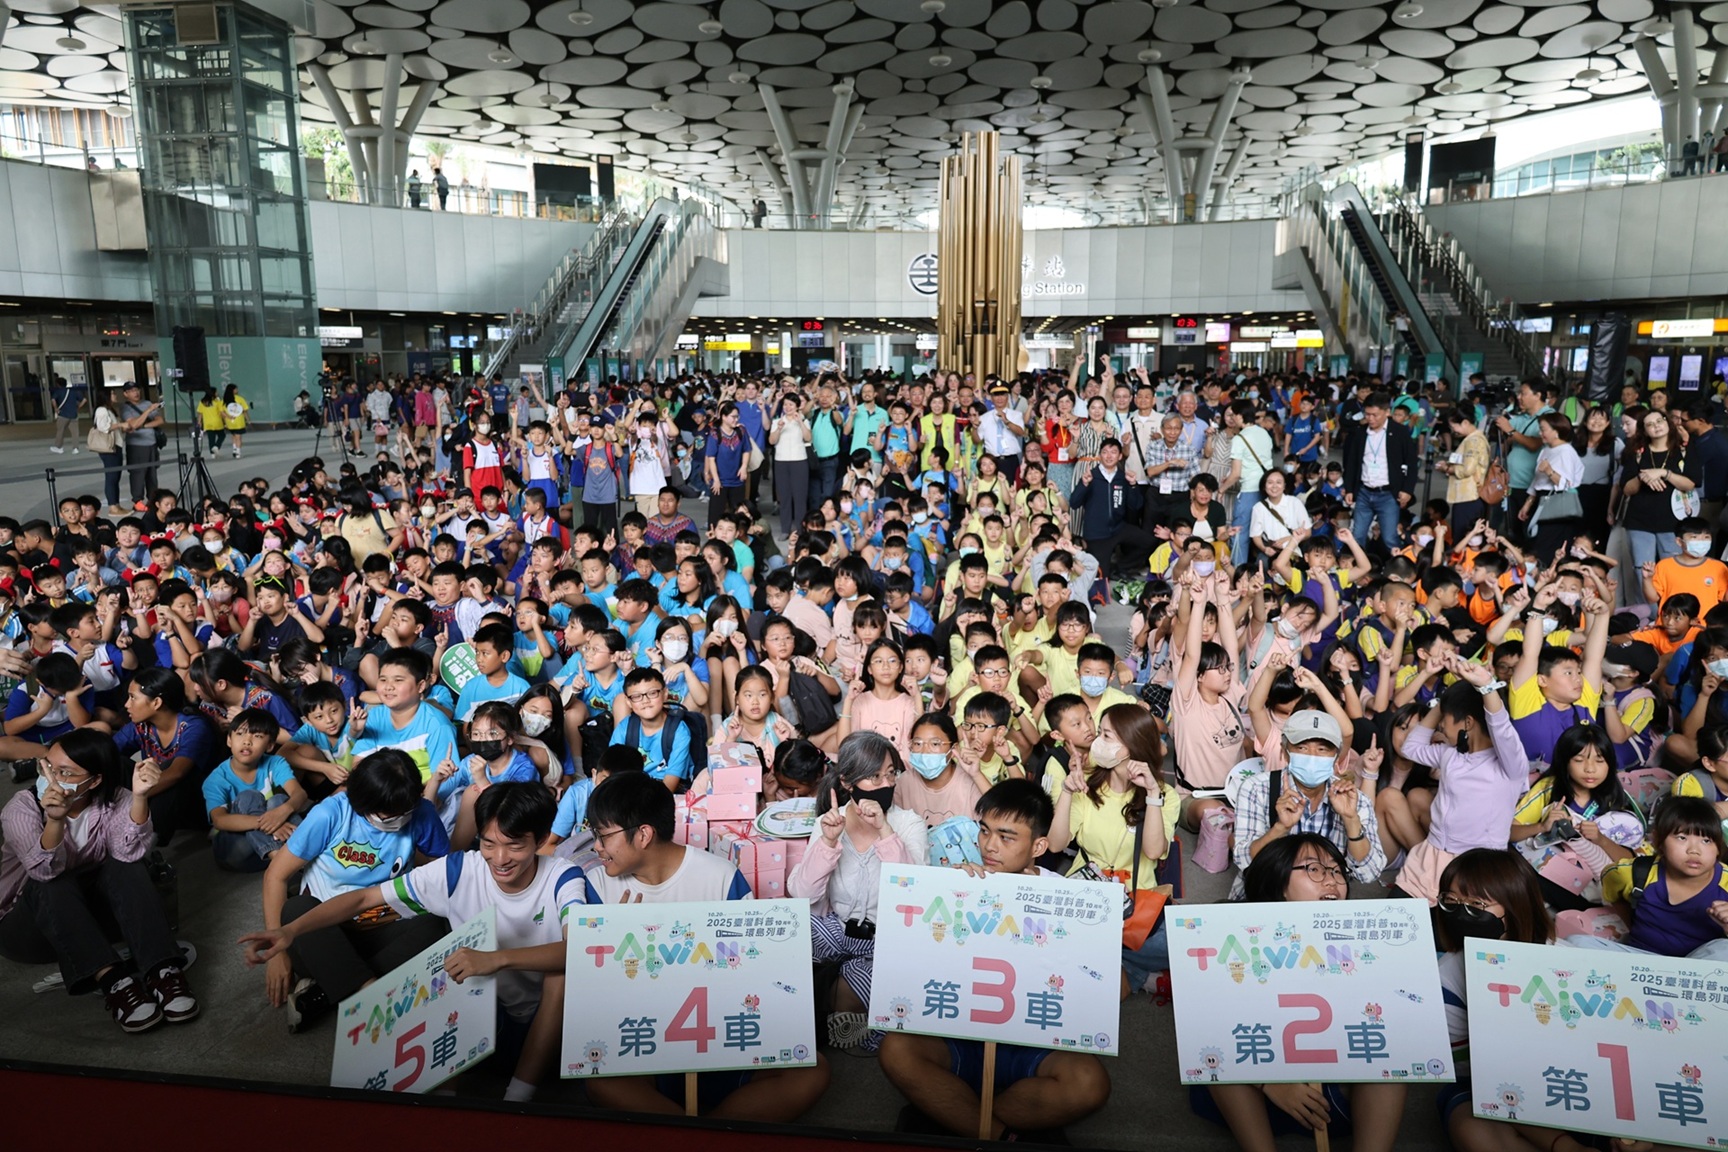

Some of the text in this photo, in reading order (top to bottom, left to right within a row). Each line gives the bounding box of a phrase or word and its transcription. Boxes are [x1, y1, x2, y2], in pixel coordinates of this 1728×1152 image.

[1035, 282, 1084, 294] Station
[337, 845, 377, 865] Class
[1053, 907, 1096, 919] 環島列車
[745, 928, 786, 937] 環島列車
[1357, 930, 1403, 940] 環島列車
[922, 957, 1064, 1030] 第3車
[618, 986, 762, 1057] 第4車
[1232, 993, 1390, 1064] 第2車
[1542, 1043, 1708, 1127] 第1車
